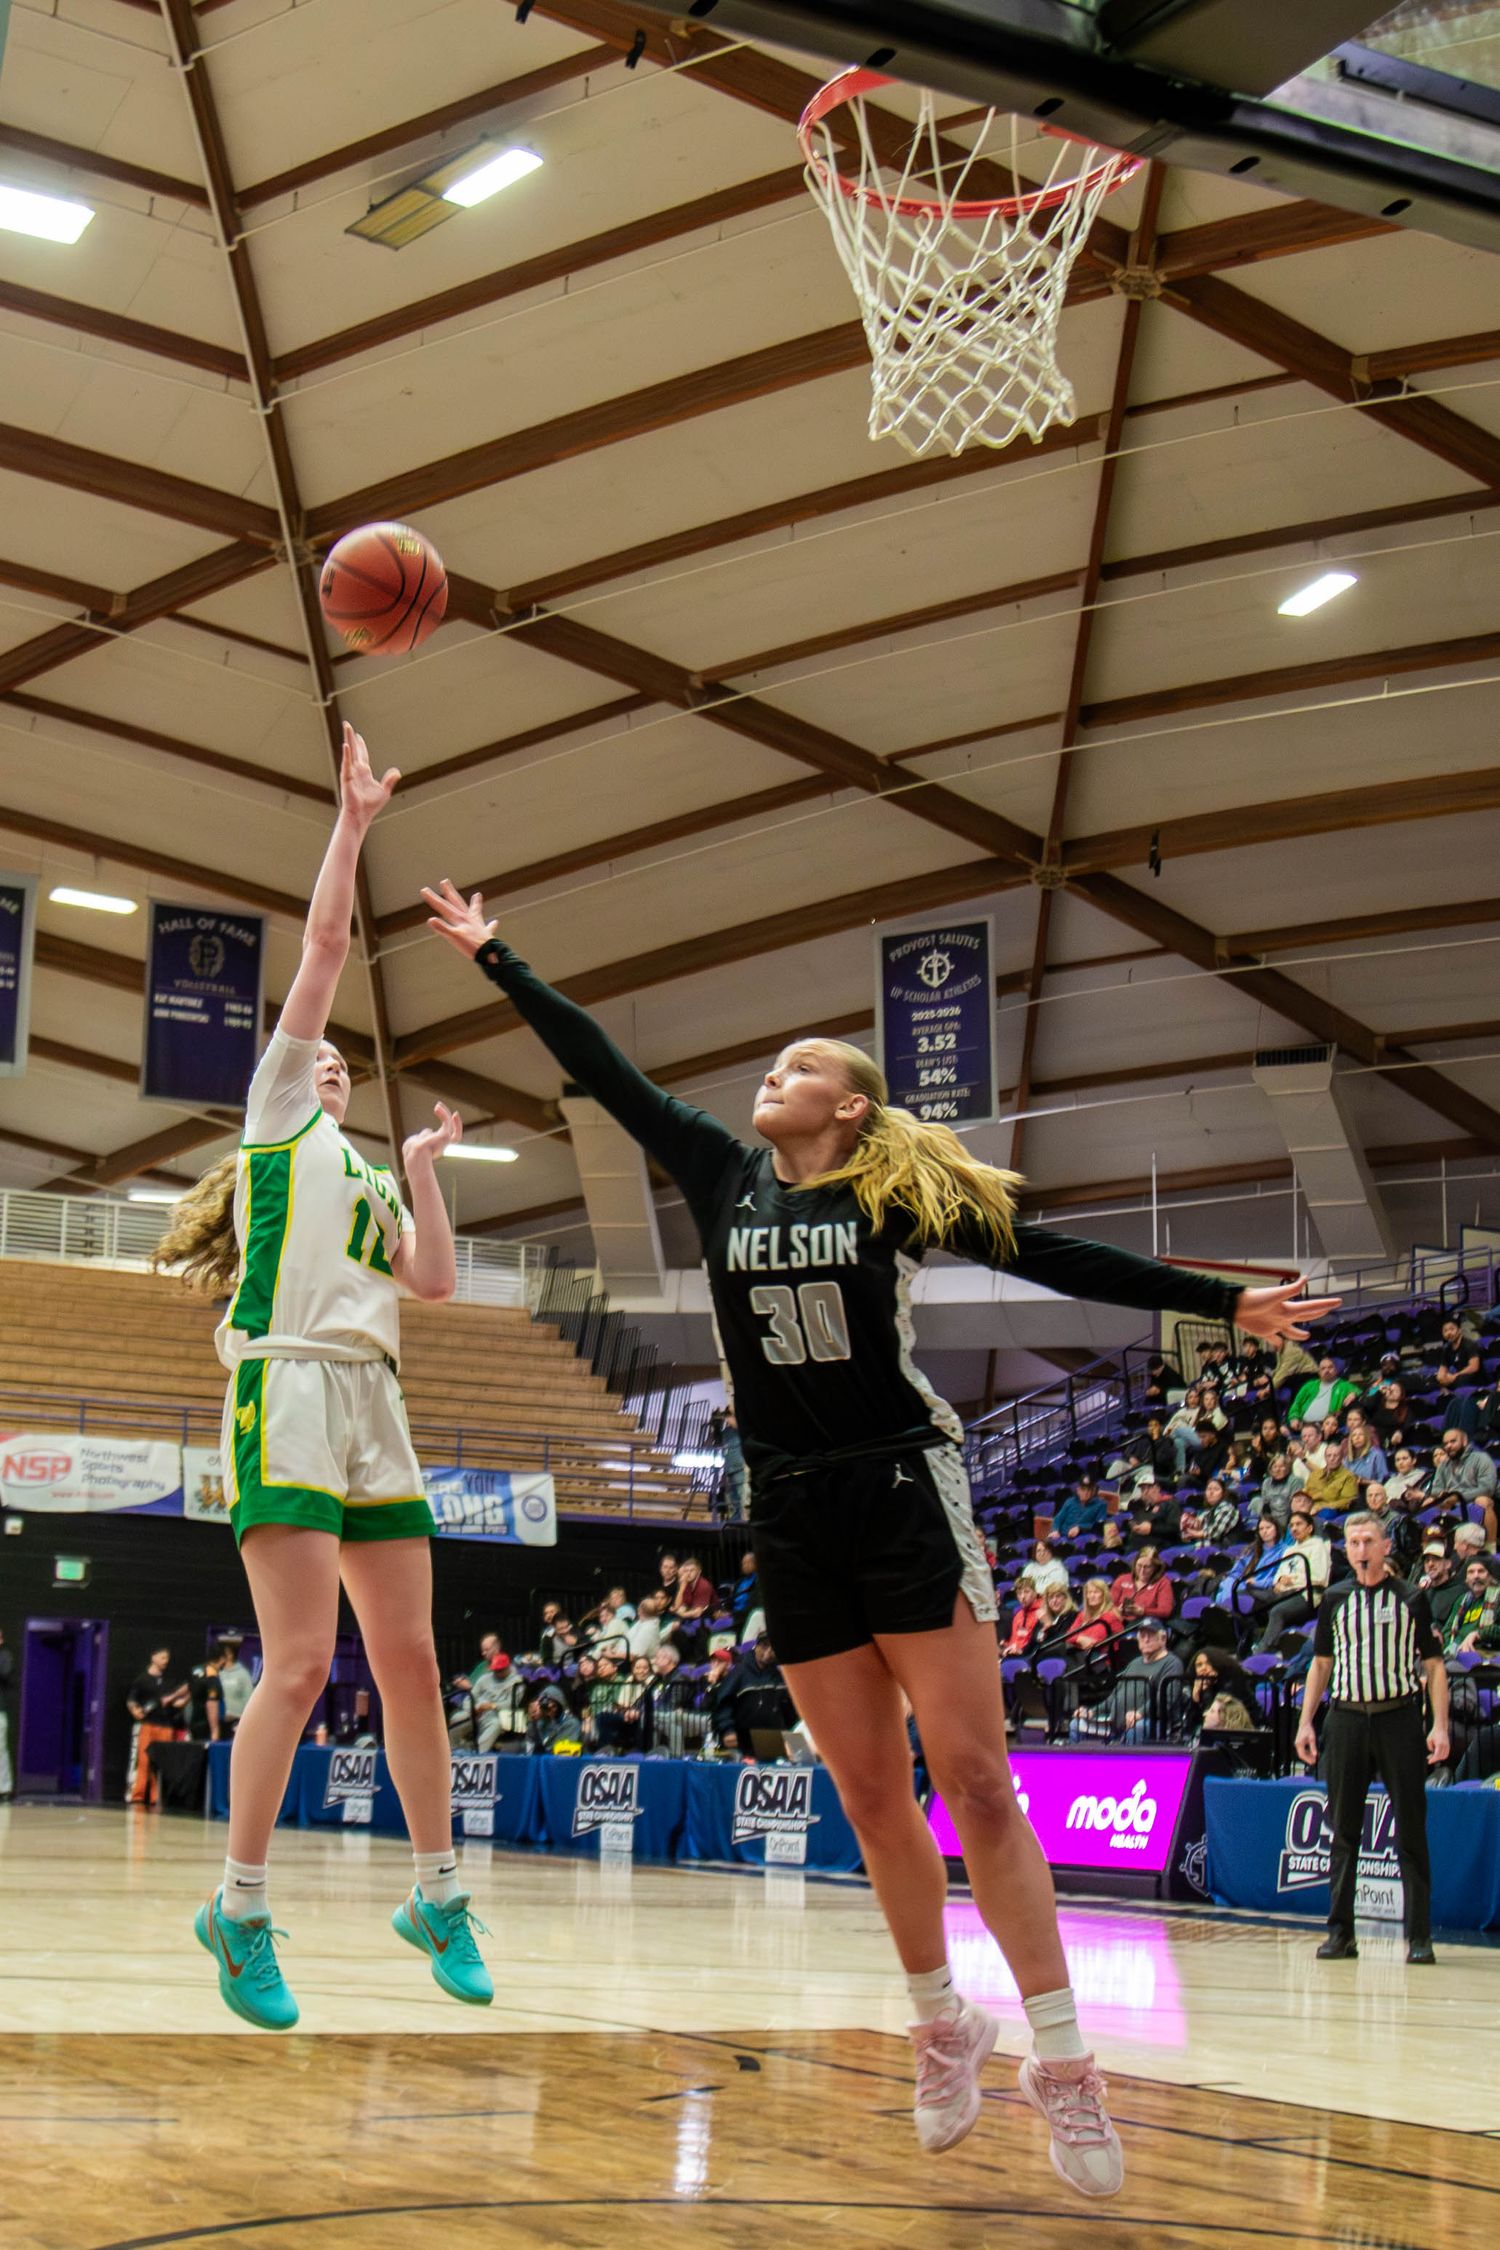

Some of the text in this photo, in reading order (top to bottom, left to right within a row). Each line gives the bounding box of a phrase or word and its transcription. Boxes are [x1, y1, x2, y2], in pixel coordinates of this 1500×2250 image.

[158, 917, 257, 947] HALL OF FAME
[889, 932, 980, 962] PROVOST SALUTES
[903, 990, 941, 1004] SCHOLAR
[917, 1033, 956, 1053] 3.52
[919, 1067, 957, 1087] 54%
[920, 1102, 958, 1120] 94%
[727, 1221, 858, 1272] NELSON
[749, 1281, 851, 1365] 30
[81, 1448, 149, 1464] Northwest
[2, 1455, 72, 1482] NSP
[81, 1460, 124, 1474] Sports
[81, 1473, 166, 1492] Photography
[464, 1474, 496, 1494] YOU
[330, 1754, 375, 1784] OSAA
[580, 1770, 636, 1808] OSAA
[738, 1772, 810, 1817] OSAA
[1065, 1778, 1157, 1833] moda
[736, 1816, 756, 1830] STATE
[1109, 1833, 1149, 1850] HEALTH
[1288, 1855, 1318, 1872] STATE
[1355, 1883, 1394, 1906] nPoint
